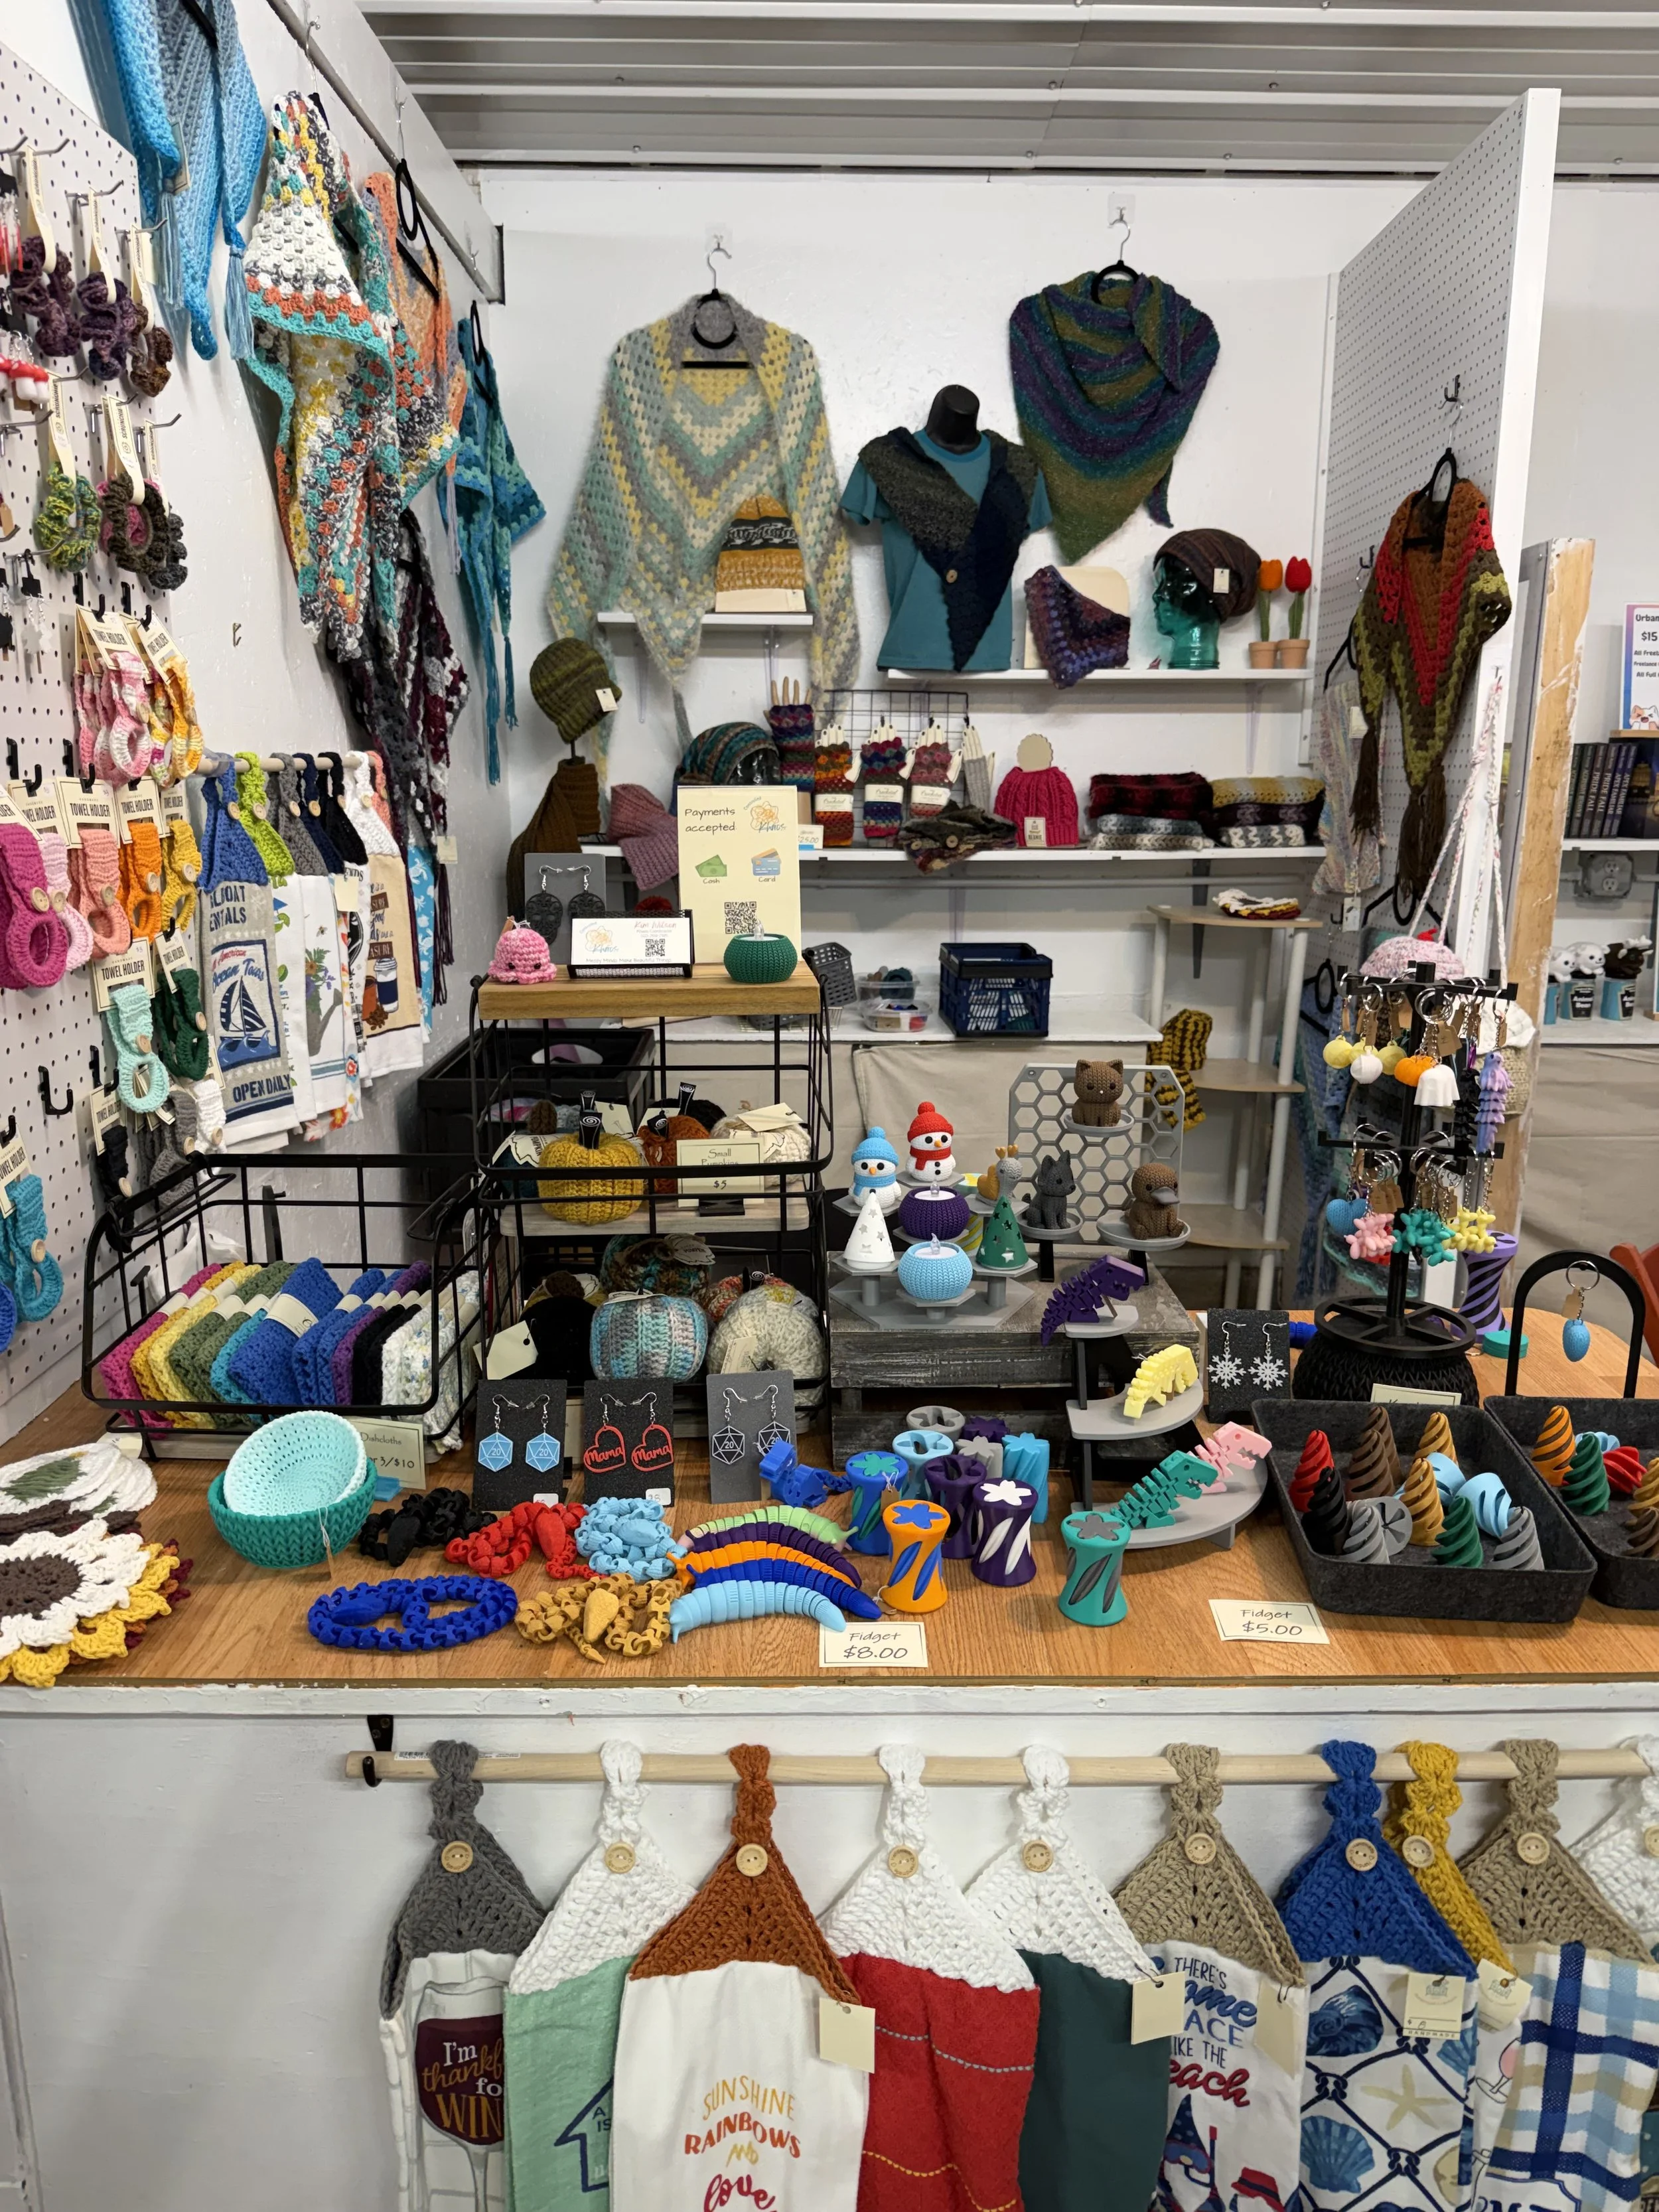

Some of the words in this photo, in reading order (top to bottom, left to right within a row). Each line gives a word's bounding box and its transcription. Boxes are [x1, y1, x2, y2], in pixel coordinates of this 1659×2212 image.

[106, 632, 127, 645] HOLDER
[1641, 631, 1658, 641] $15
[36, 806, 56, 820] HOLDER
[70, 803, 90, 817] TOWEL
[90, 804, 111, 817] HOLDER
[121, 800, 135, 814] TOWEL
[135, 798, 154, 812] HOLDER
[685, 807, 736, 821] Payments
[685, 822, 735, 836] accepted
[210, 907, 247, 932] ENTALS
[101, 966, 122, 981] TOWEL
[122, 960, 145, 976] HOLDER
[232, 1078, 265, 1103] OPEN
[265, 1074, 291, 1094] DAILY
[0, 1159, 13, 1178] OWEL
[13, 1146, 27, 1170] HOLDER
[707, 1147, 731, 1159] Small
[713, 1180, 727, 1190] $5
[360, 1432, 402, 1445] Dishcloths
[587, 1446, 623, 1465] Mama
[634, 1445, 671, 1463] Mama
[1240, 1609, 1293, 1620] Fidget
[849, 1631, 902, 1644] Fidget
[1242, 1621, 1303, 1636] $5.00
[843, 1645, 908, 1659] $8.00
[1175, 1957, 1227, 1990] THERE'S
[1184, 2009, 1244, 2049] ACE
[443, 2042, 478, 2067] I'm
[1173, 2036, 1194, 2057] IKE
[1203, 2041, 1228, 2069] THE
[421, 2037, 502, 2093] thankf
[475, 2077, 502, 2097] fo
[1170, 2059, 1250, 2108] each
[702, 2075, 795, 2122] SUNSHINE
[435, 2093, 502, 2139] WIN
[592, 2106, 606, 2120] A
[684, 2111, 800, 2158] RAINBOWS
[703, 2174, 776, 2212] love
